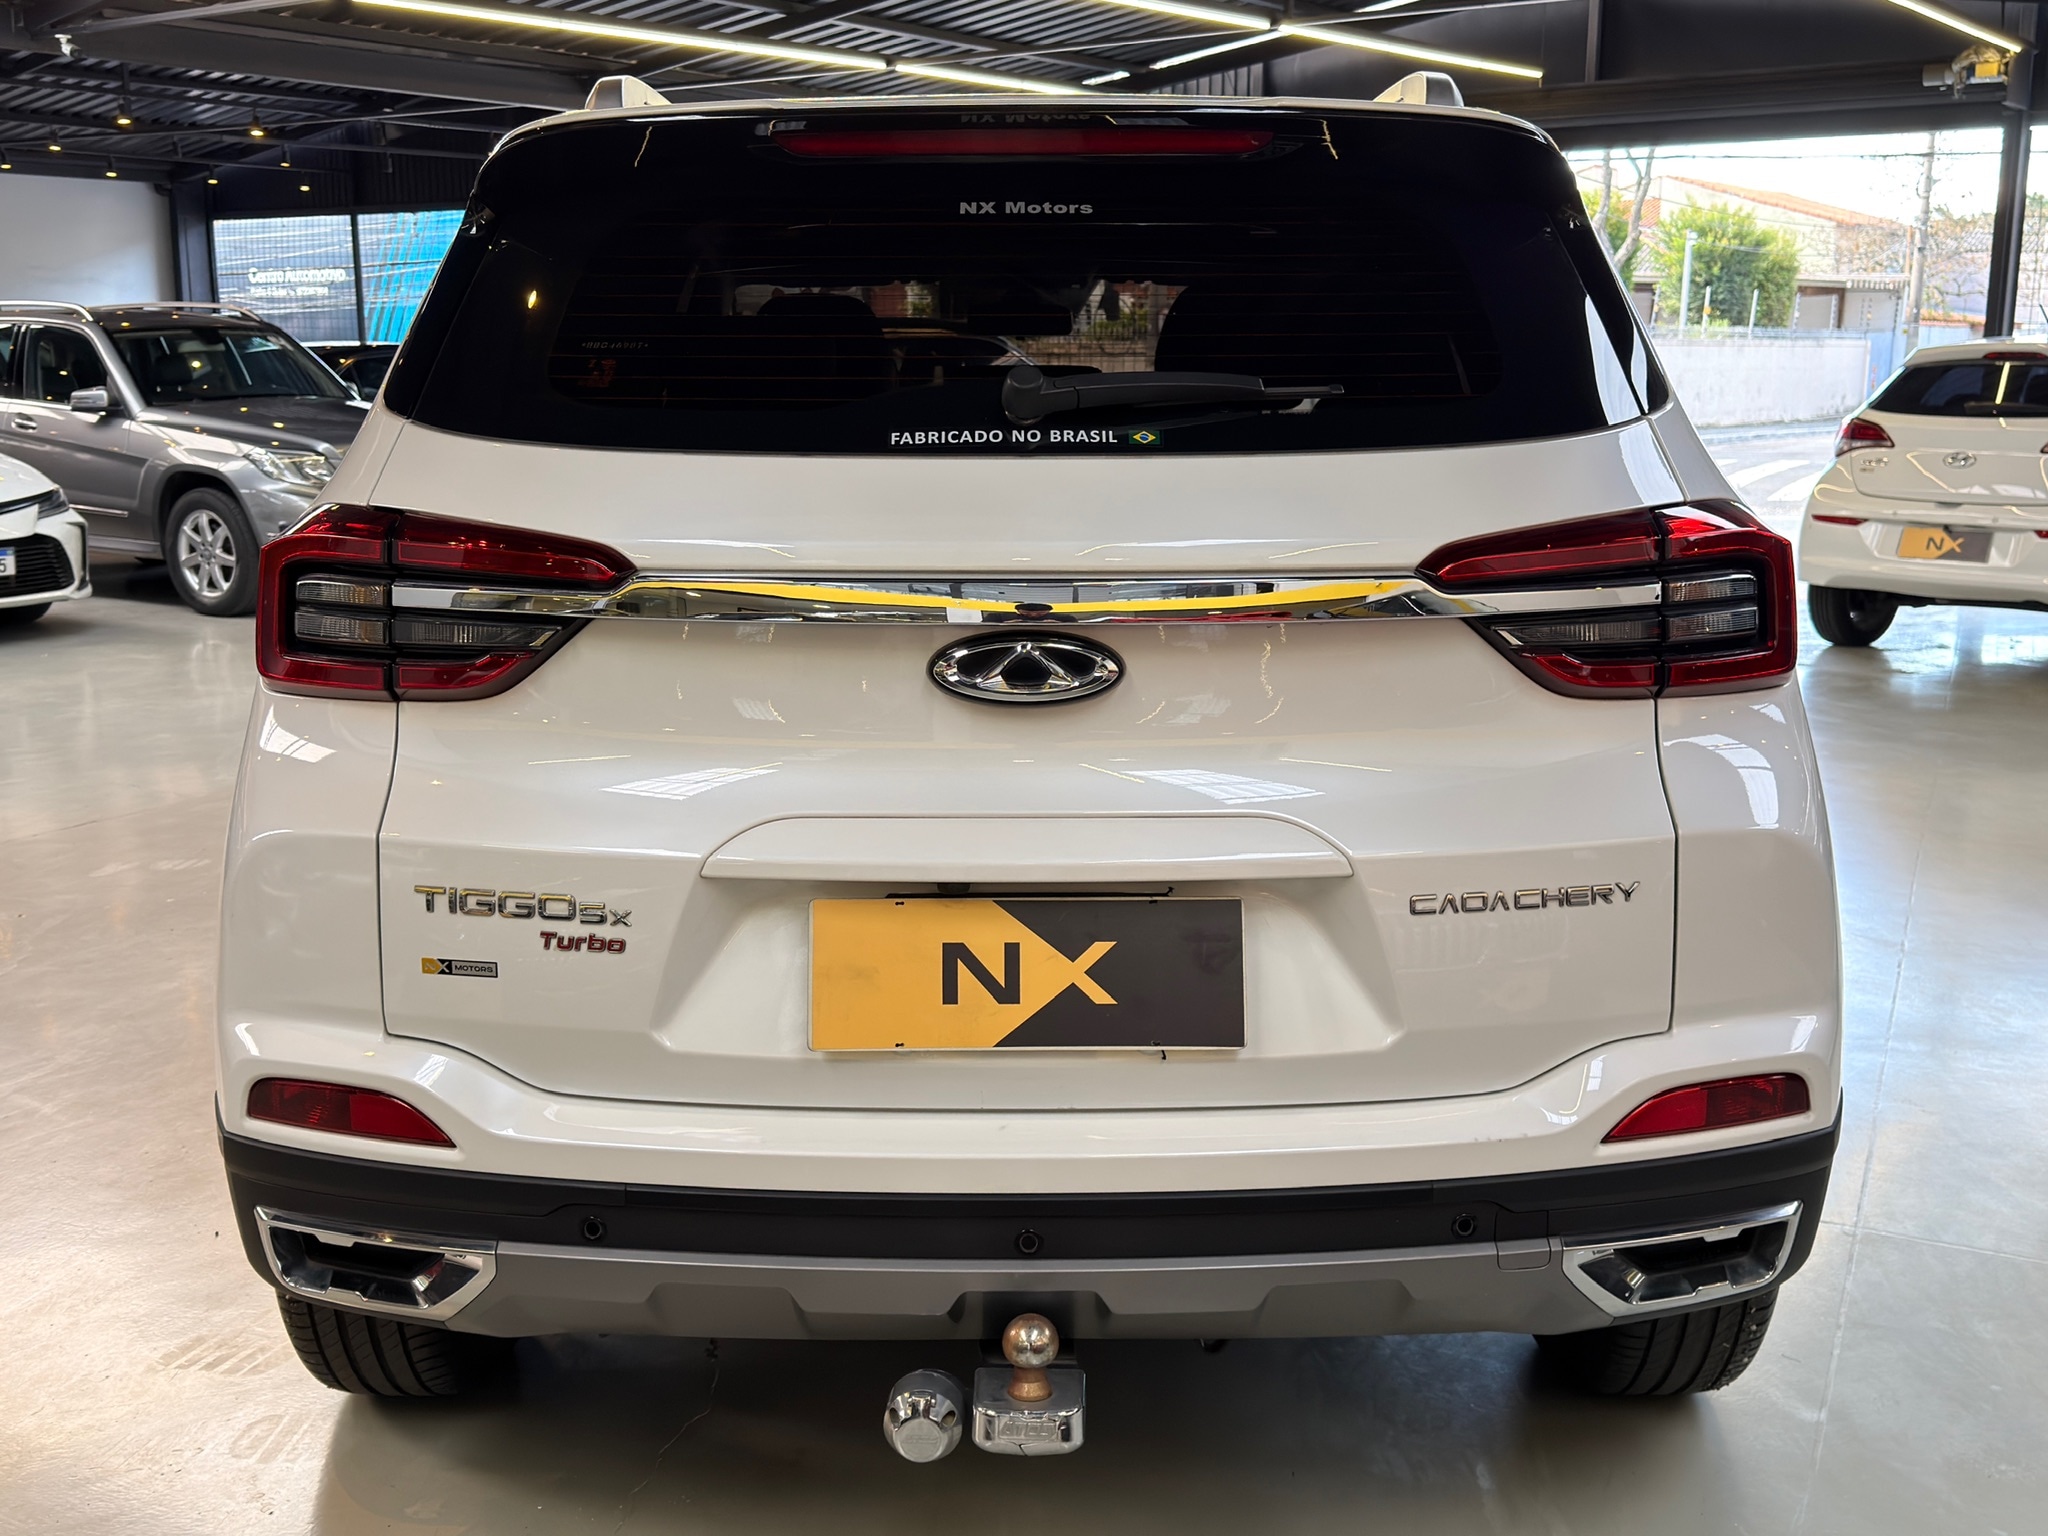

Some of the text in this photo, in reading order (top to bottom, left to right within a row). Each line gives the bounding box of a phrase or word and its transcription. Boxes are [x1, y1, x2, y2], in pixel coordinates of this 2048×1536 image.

[959, 201, 1093, 214] NX Motors
[890, 429, 1118, 445] FABRICADO NO BRASIL
[1925, 536, 1965, 553] NX
[540, 930, 626, 954] Turbo
[455, 964, 493, 973] MOTORS
[942, 941, 1118, 1006] NX
